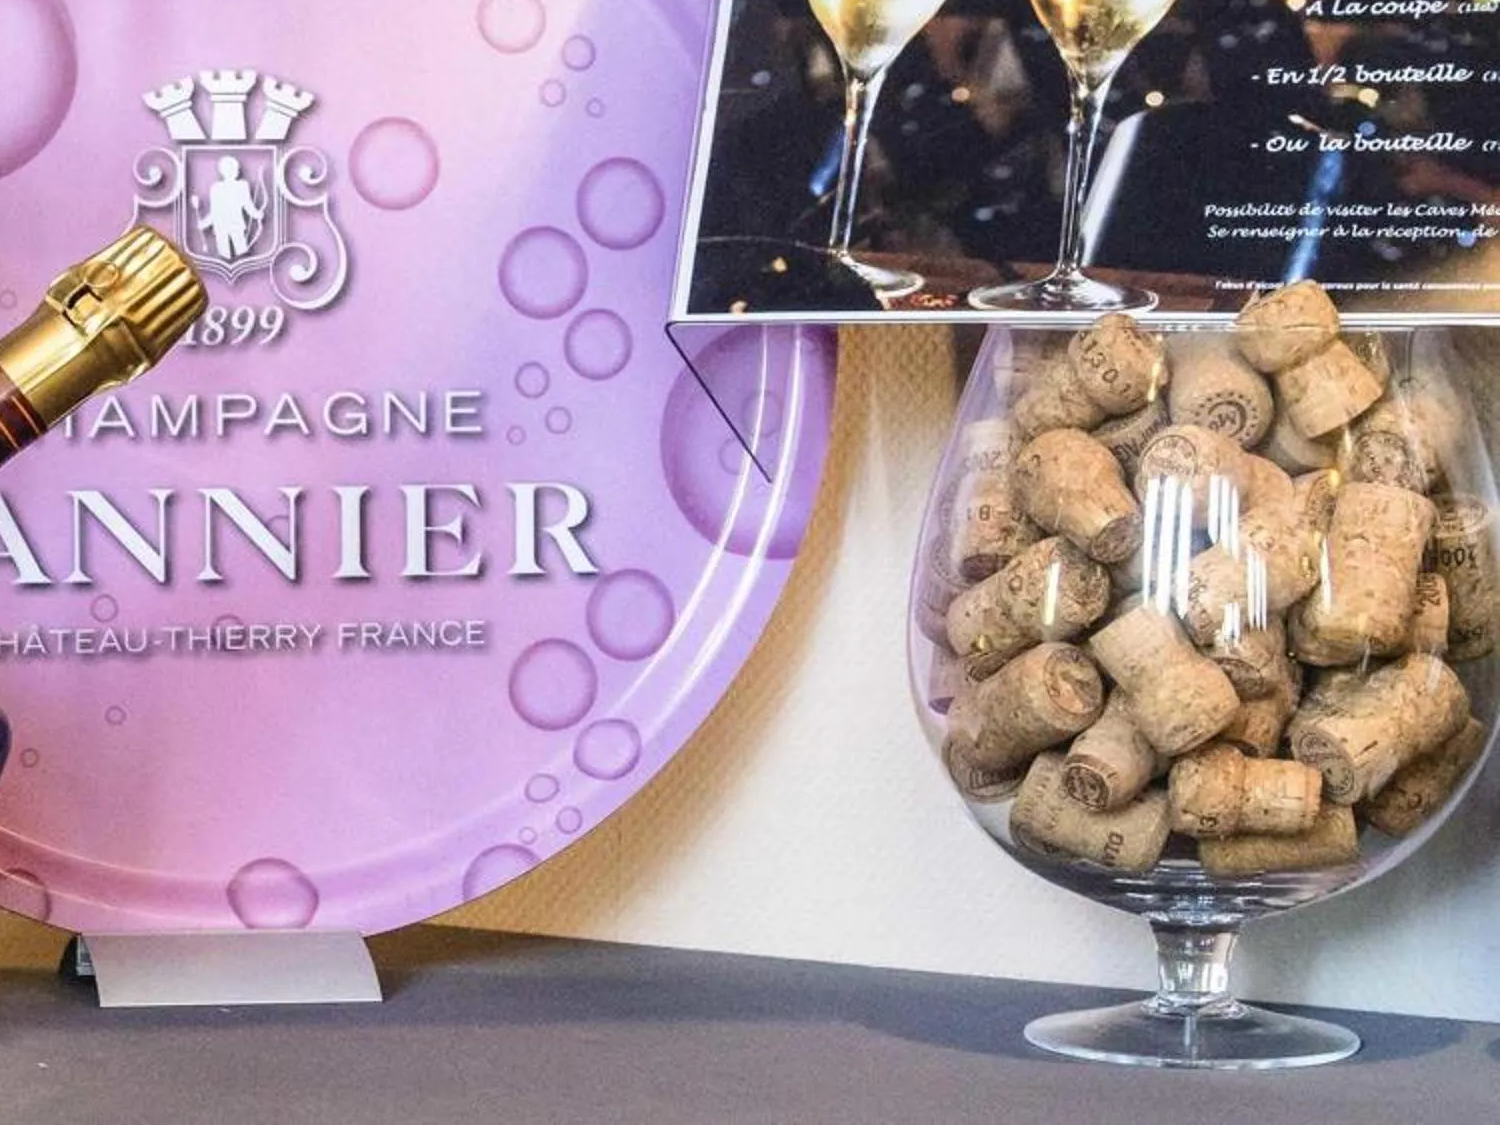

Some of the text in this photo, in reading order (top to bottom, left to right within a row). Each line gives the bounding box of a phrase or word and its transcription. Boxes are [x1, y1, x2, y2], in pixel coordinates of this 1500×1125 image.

[1306, 0, 1324, 17] A
[1332, 0, 1370, 15] La
[1267, 68, 1304, 84] En
[1308, 66, 1346, 85] 1/2
[1355, 63, 1475, 84] bouteille
[1265, 136, 1309, 153] Ou
[1318, 133, 1349, 151] la
[1354, 132, 1475, 152] bouteille
[1204, 202, 1296, 218] Possibilité
[1298, 202, 1326, 216] de
[1326, 203, 1384, 217] visiter
[1387, 202, 1413, 218] les
[1414, 203, 1469, 218] Caves
[1206, 224, 1230, 238] Se
[1231, 226, 1330, 242] renseigner
[1332, 223, 1350, 238] à
[1351, 223, 1375, 238] la
[1473, 223, 1499, 238] de
[62, 389, 485, 439] AMPAGNE
[336, 620, 486, 649] FRANCE
